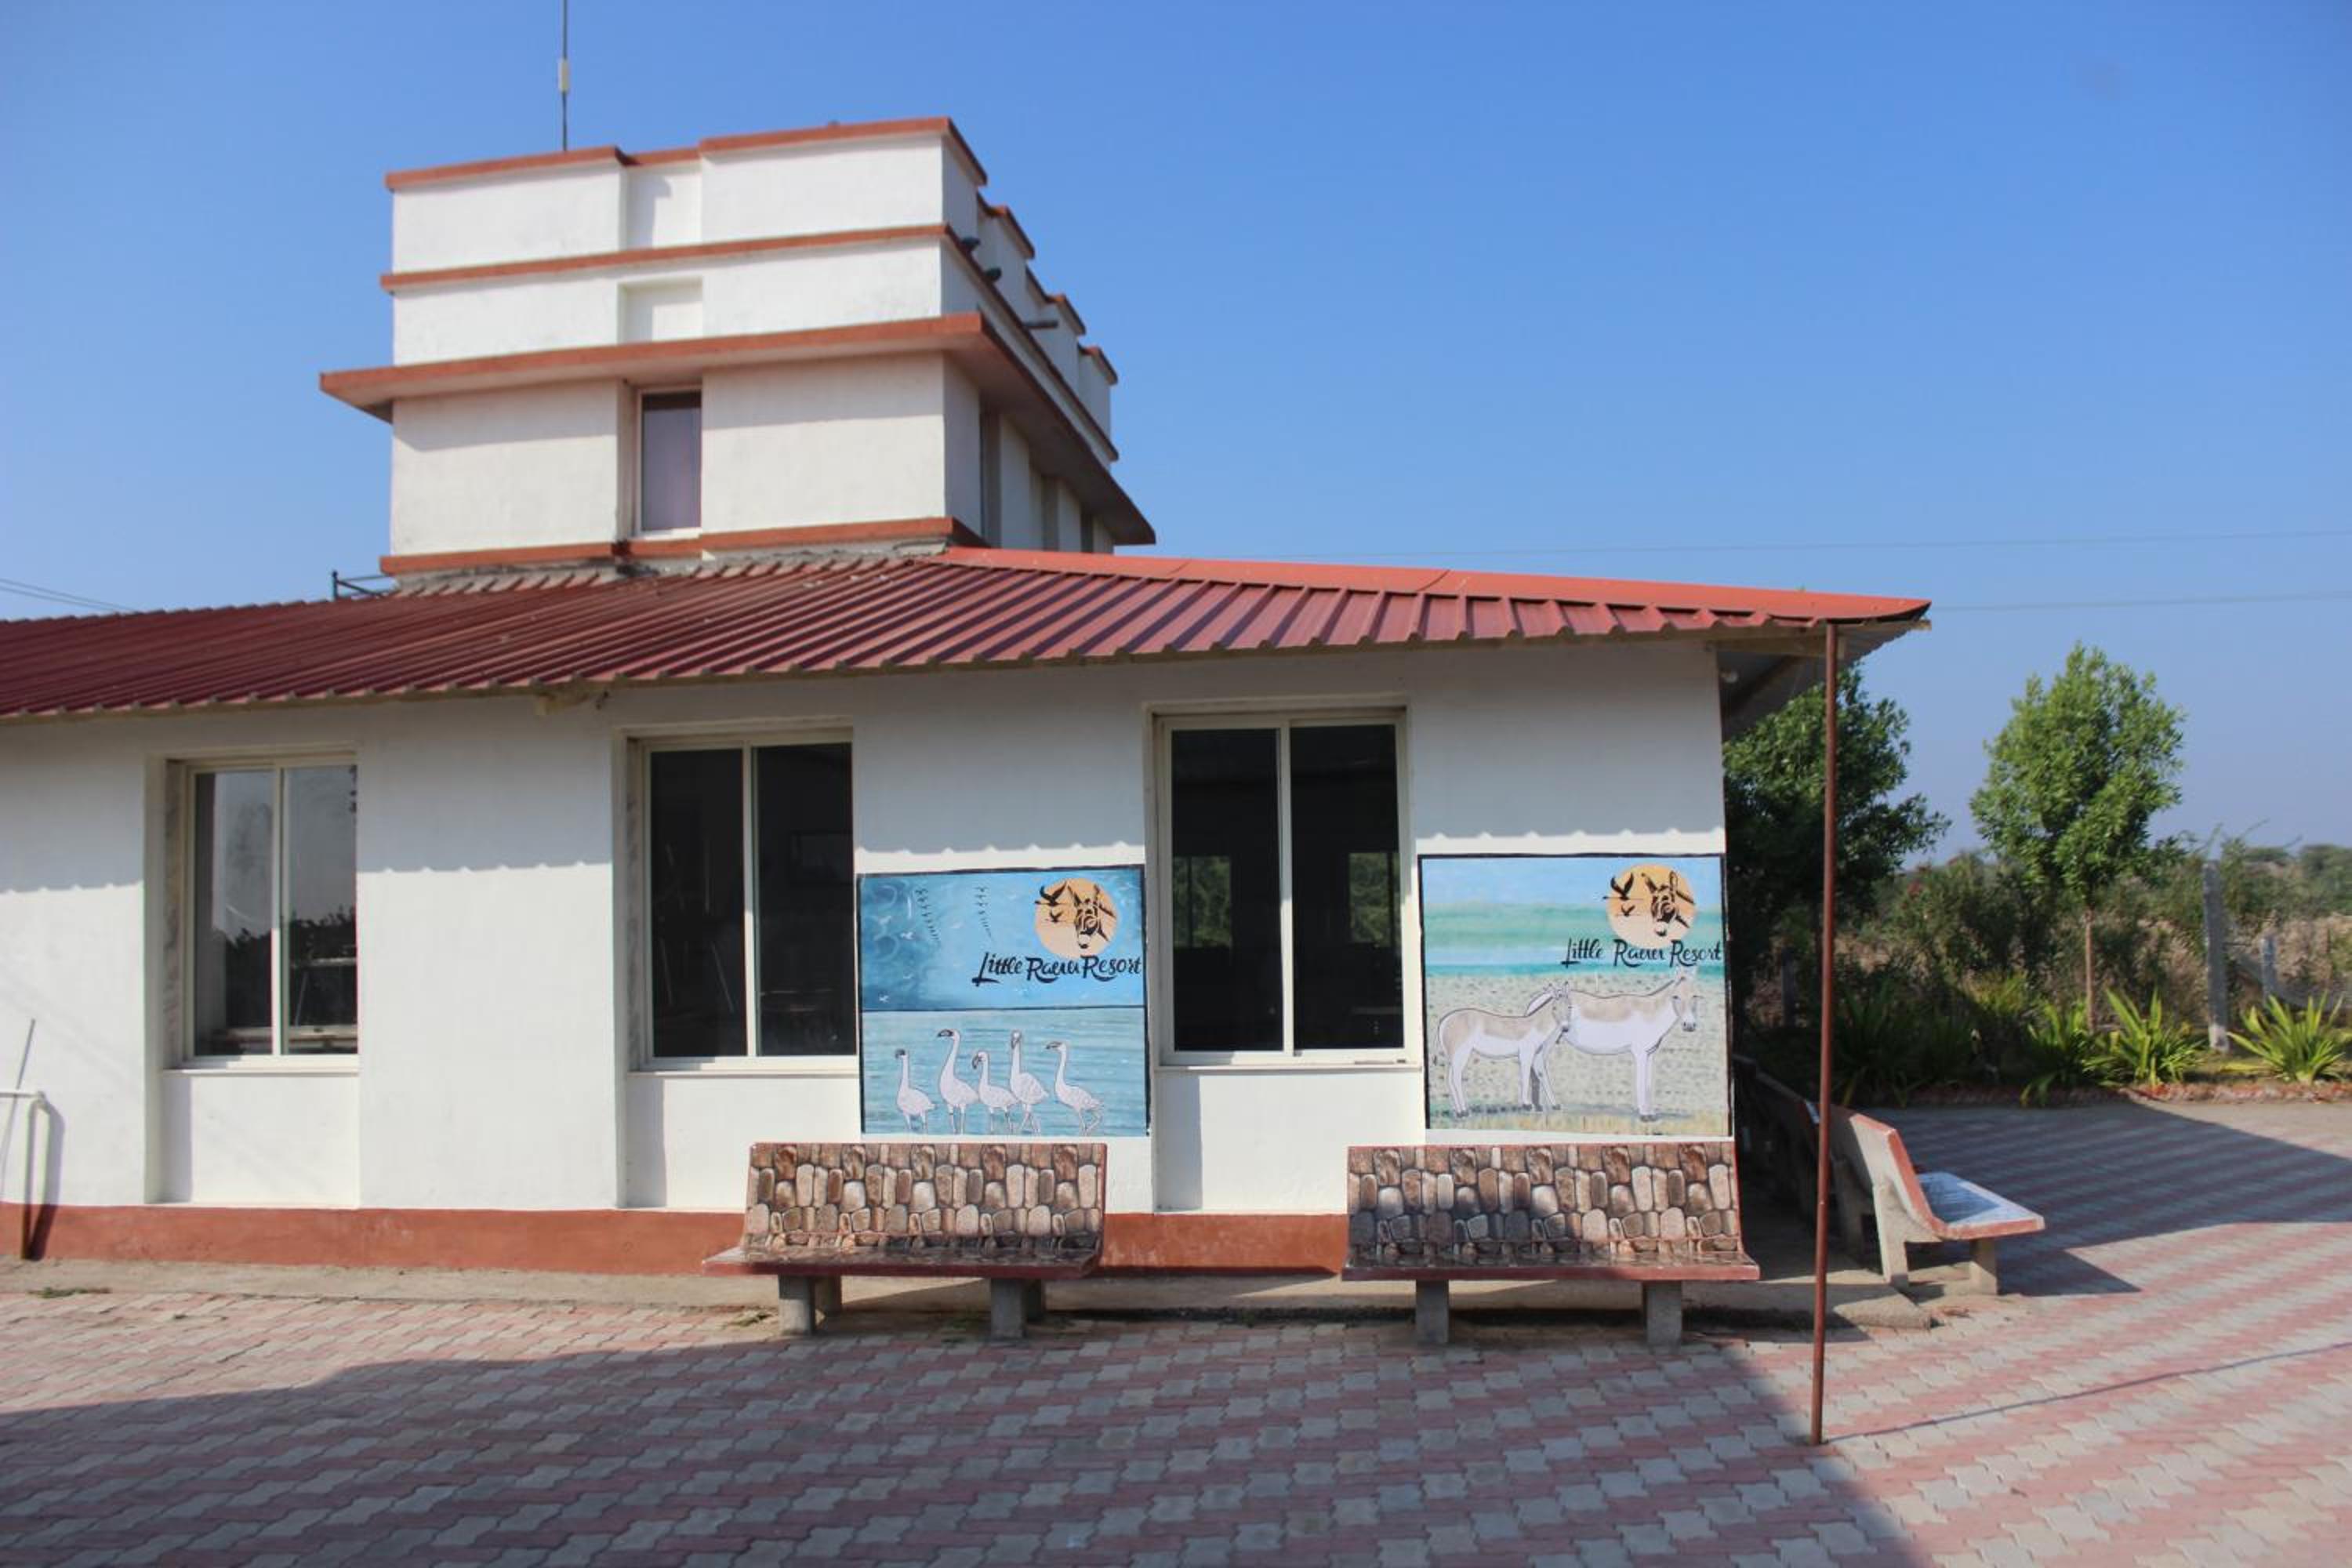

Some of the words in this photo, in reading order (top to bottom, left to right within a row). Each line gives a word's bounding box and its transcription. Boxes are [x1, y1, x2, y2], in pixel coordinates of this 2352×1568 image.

[971, 952, 1022, 986] Little
[1080, 954, 1142, 982] Resort
[1560, 938, 1605, 968] Little
[1669, 938, 1722, 968] Resort
